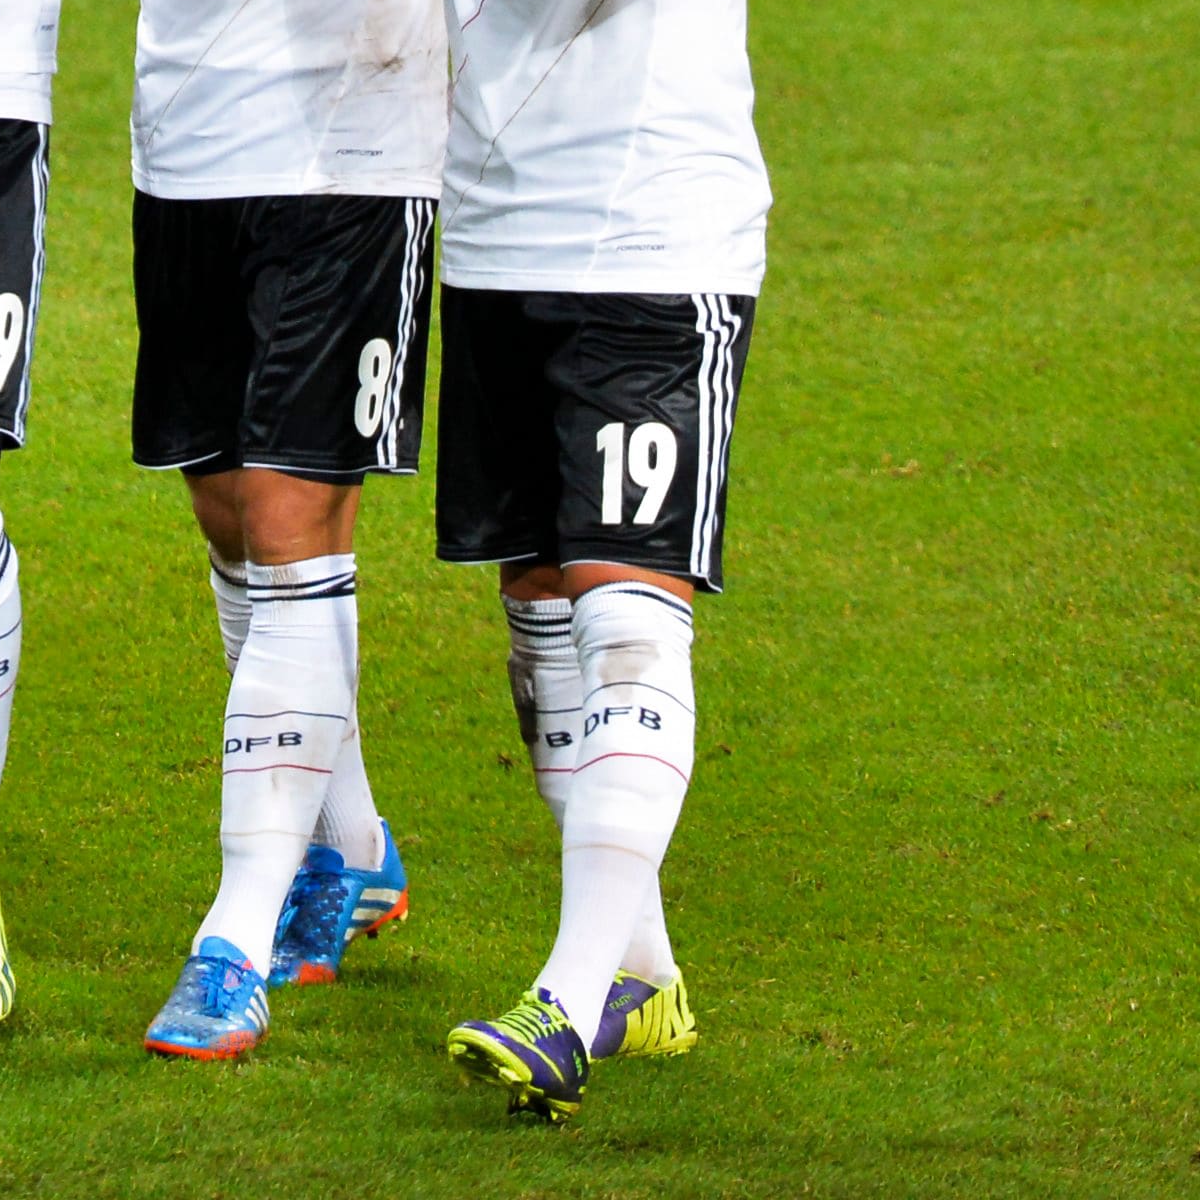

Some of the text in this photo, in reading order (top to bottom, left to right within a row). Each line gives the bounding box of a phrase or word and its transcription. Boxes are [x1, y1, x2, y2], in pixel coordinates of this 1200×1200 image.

[354, 337, 391, 437] 8
[596, 421, 677, 524] 19
[225, 732, 302, 753] DFB
[584, 706, 661, 737] DFB
